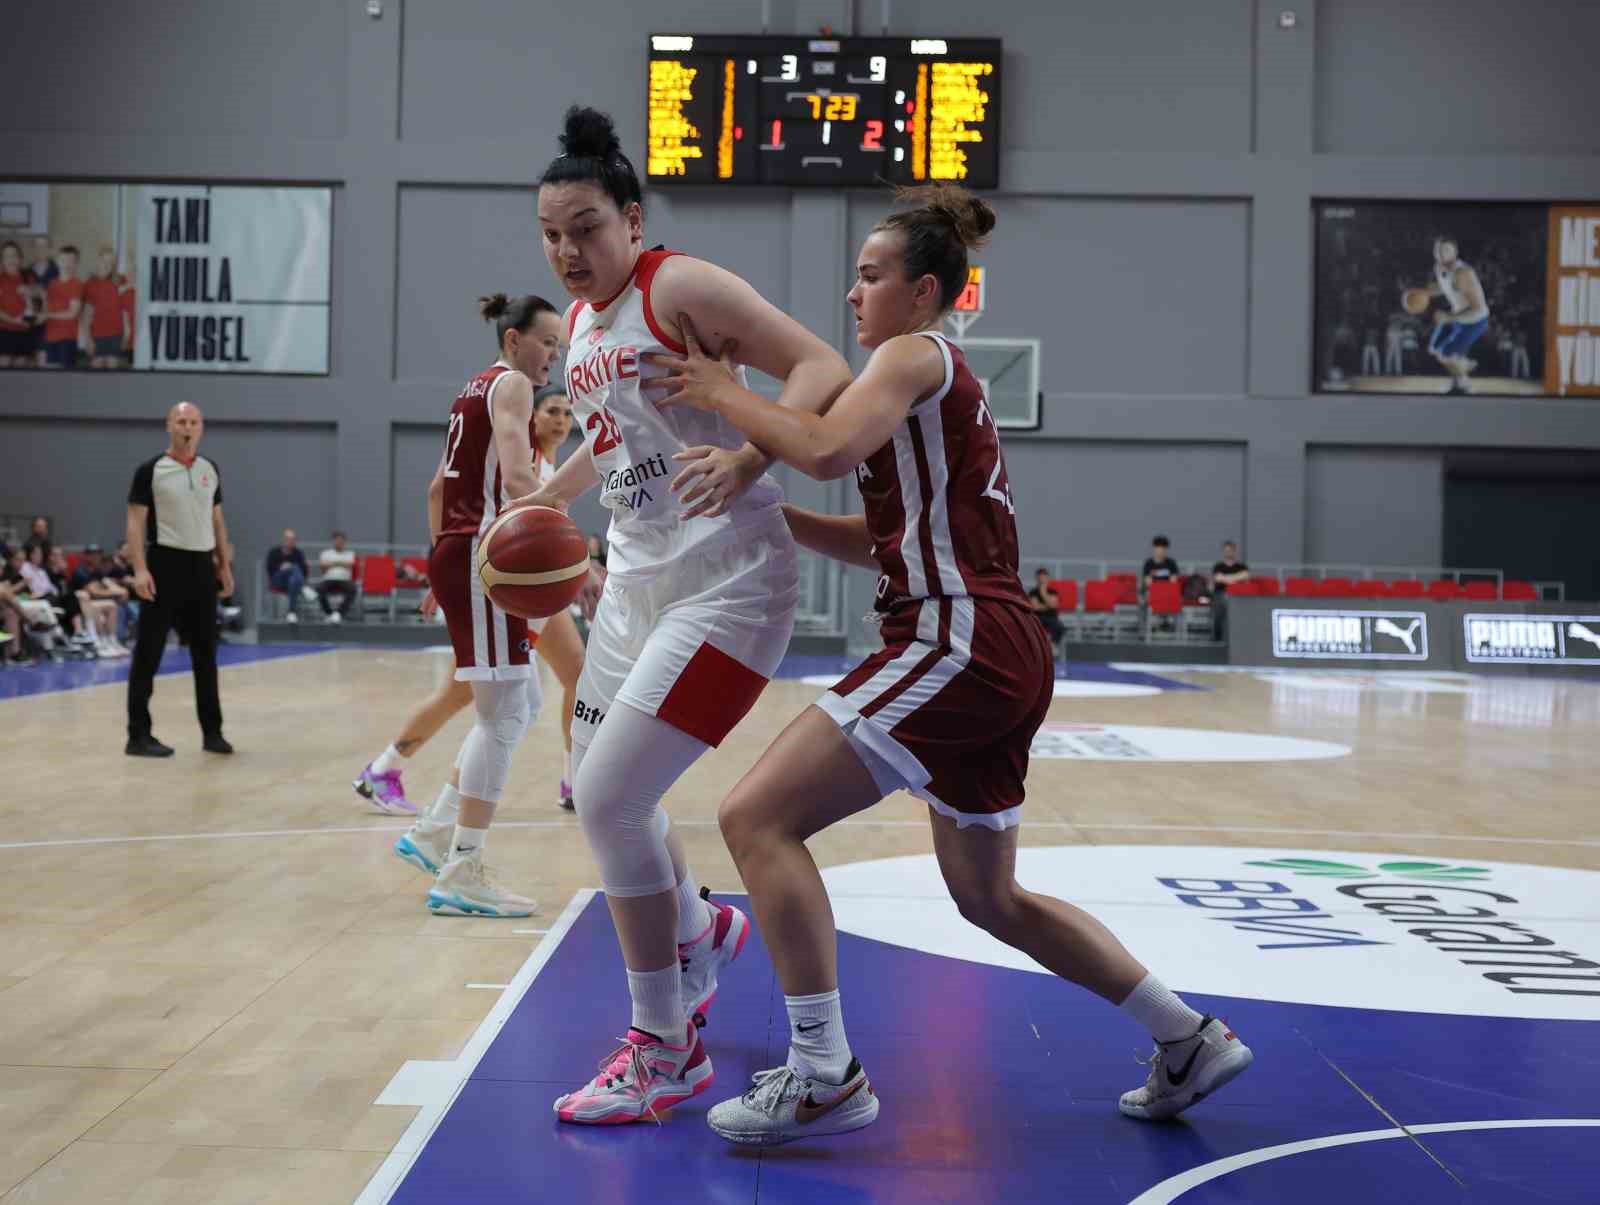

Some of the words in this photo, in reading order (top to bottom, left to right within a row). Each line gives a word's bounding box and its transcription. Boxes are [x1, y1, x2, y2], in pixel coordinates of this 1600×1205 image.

[781, 55, 797, 80] 3
[870, 56, 886, 81] 9
[864, 120, 883, 148] 2
[567, 346, 639, 404] RKİYE
